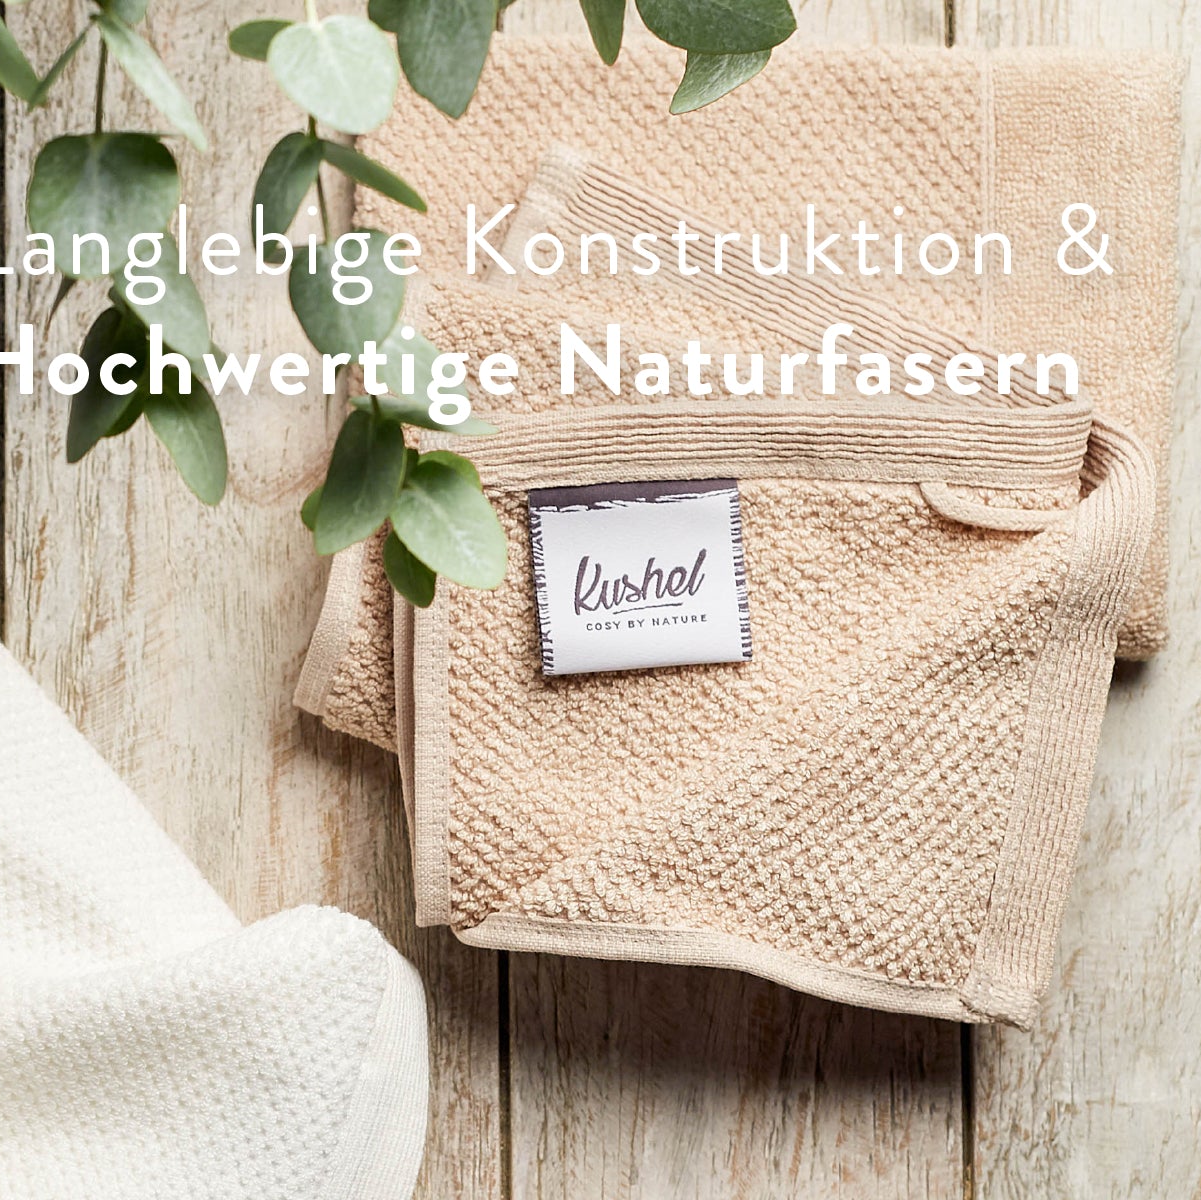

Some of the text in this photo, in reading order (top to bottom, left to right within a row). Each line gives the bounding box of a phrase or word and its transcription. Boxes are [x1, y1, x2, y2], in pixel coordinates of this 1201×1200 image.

[573, 548, 707, 616] Kushel
[586, 613, 708, 631] COSY BY NATURE
